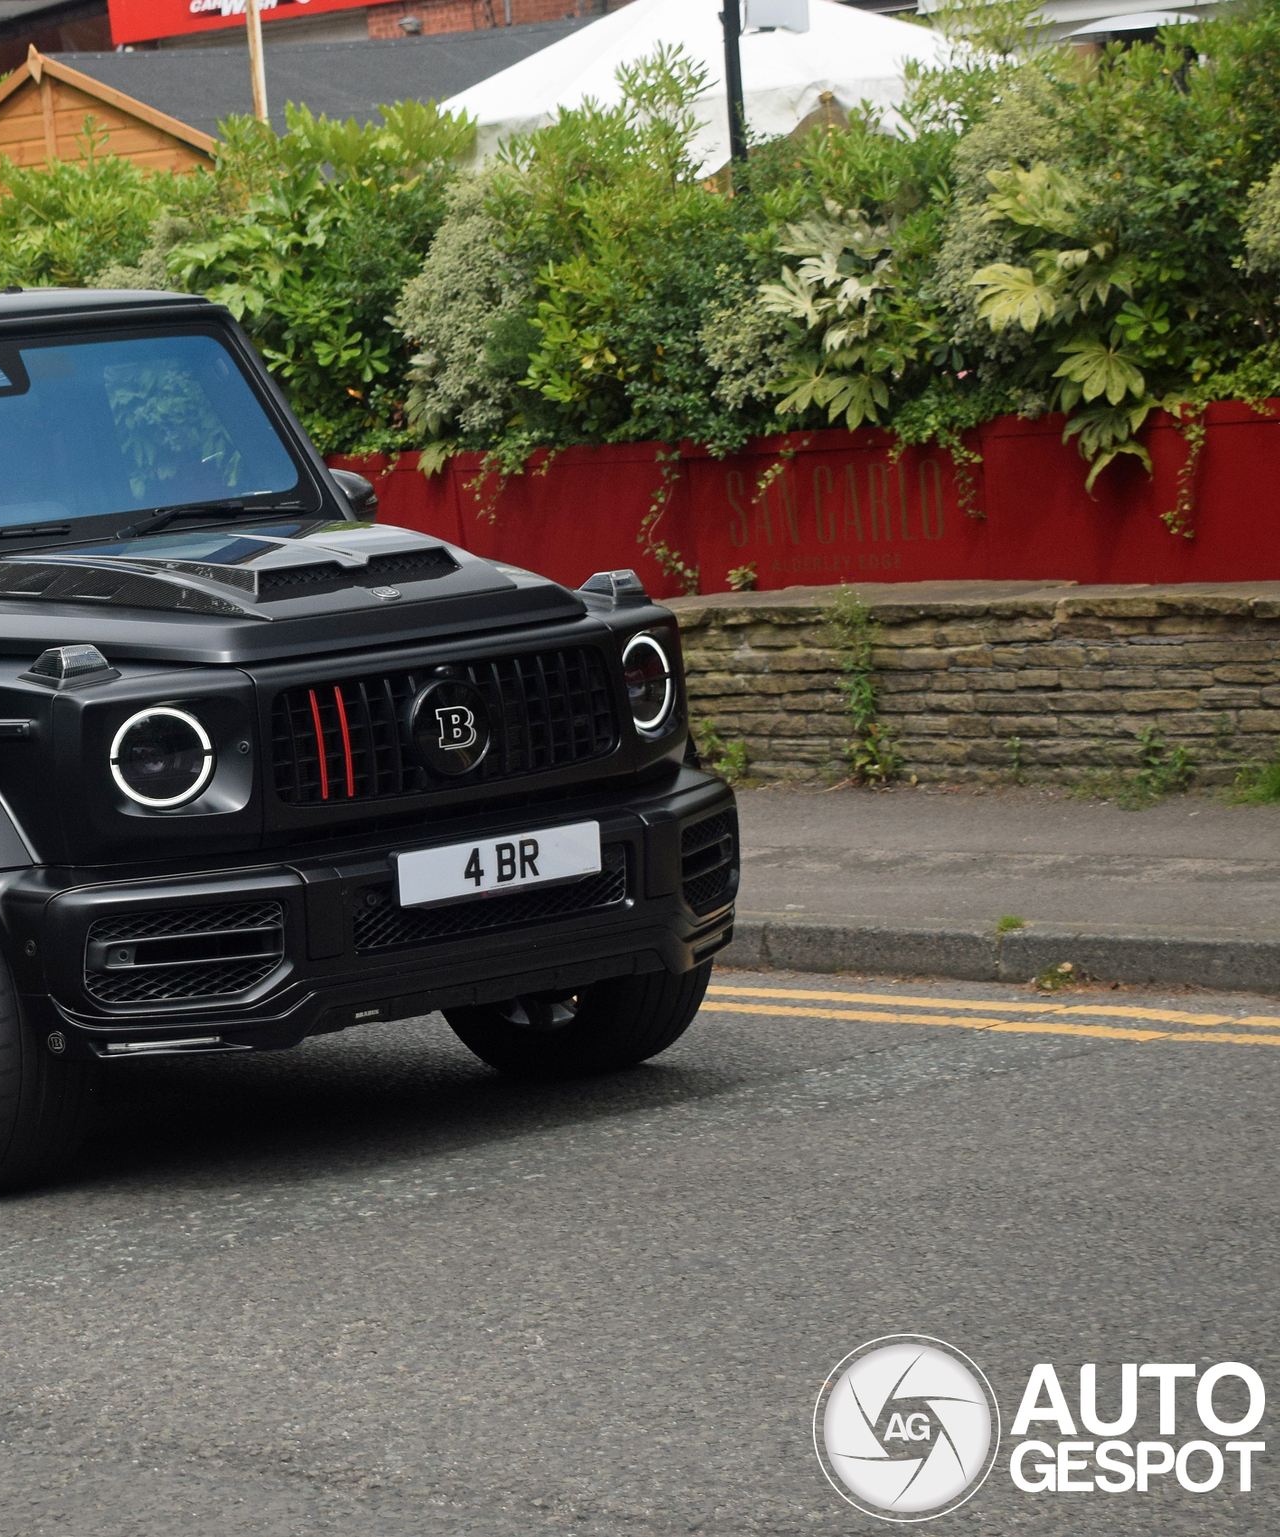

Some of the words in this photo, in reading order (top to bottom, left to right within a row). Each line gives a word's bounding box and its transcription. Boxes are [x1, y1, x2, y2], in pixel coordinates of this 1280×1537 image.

[727, 468, 800, 547] SAN
[814, 459, 945, 544] CARLO
[772, 555, 851, 573] ALDERLEY
[860, 552, 903, 570] EDGE
[435, 706, 477, 751] B
[464, 847, 485, 887] 4
[495, 838, 539, 883] BR
